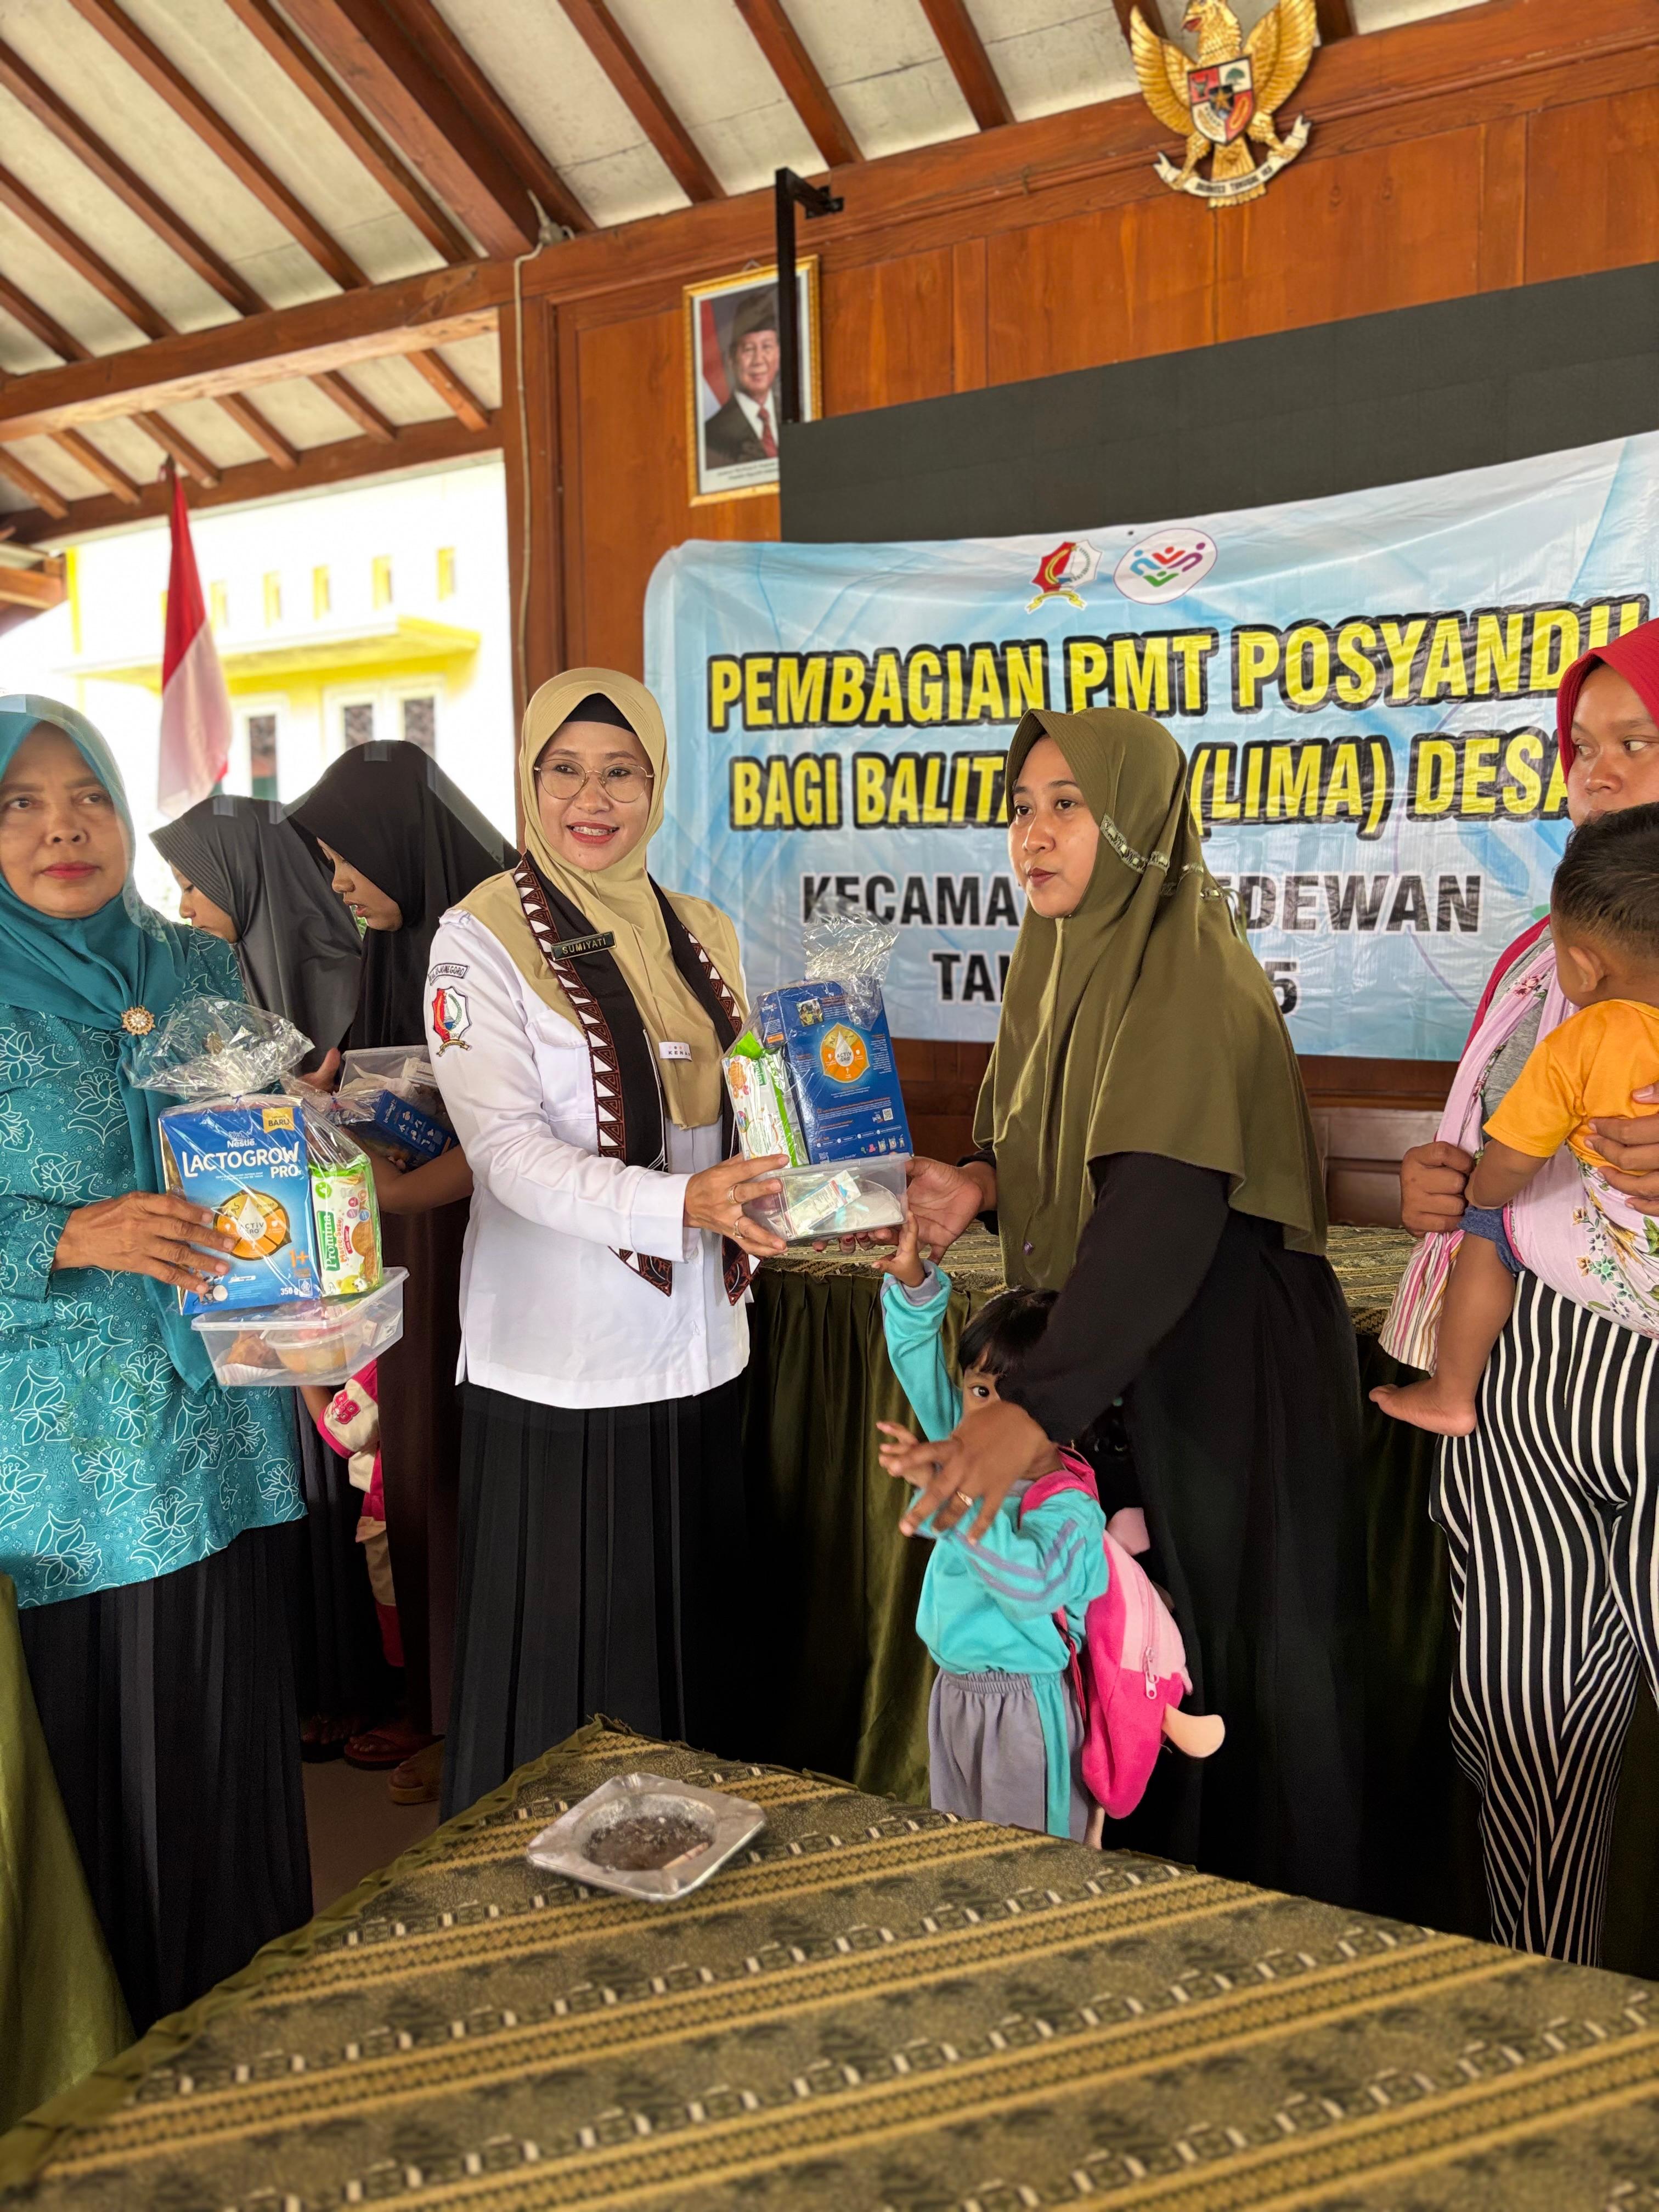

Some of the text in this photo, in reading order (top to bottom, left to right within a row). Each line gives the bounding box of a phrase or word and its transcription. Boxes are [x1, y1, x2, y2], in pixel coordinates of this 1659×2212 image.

[709, 642, 1047, 730] PEMBAGIAN
[1067, 633, 1214, 716] PMT
[729, 755, 839, 828] BAGI
[854, 753, 1010, 826] BALIT
[1188, 741, 1389, 837] (LIMA)
[803, 874, 1482, 934] KECAMA DEWAN
[562, 937, 606, 955] SUMIYATI
[268, 1118, 290, 1126] BARU
[182, 1141, 300, 1178] LACTOGROW
[270, 1164, 299, 1179] PRO
[321, 1214, 337, 1268] Promina
[280, 1287, 293, 1295] 350
